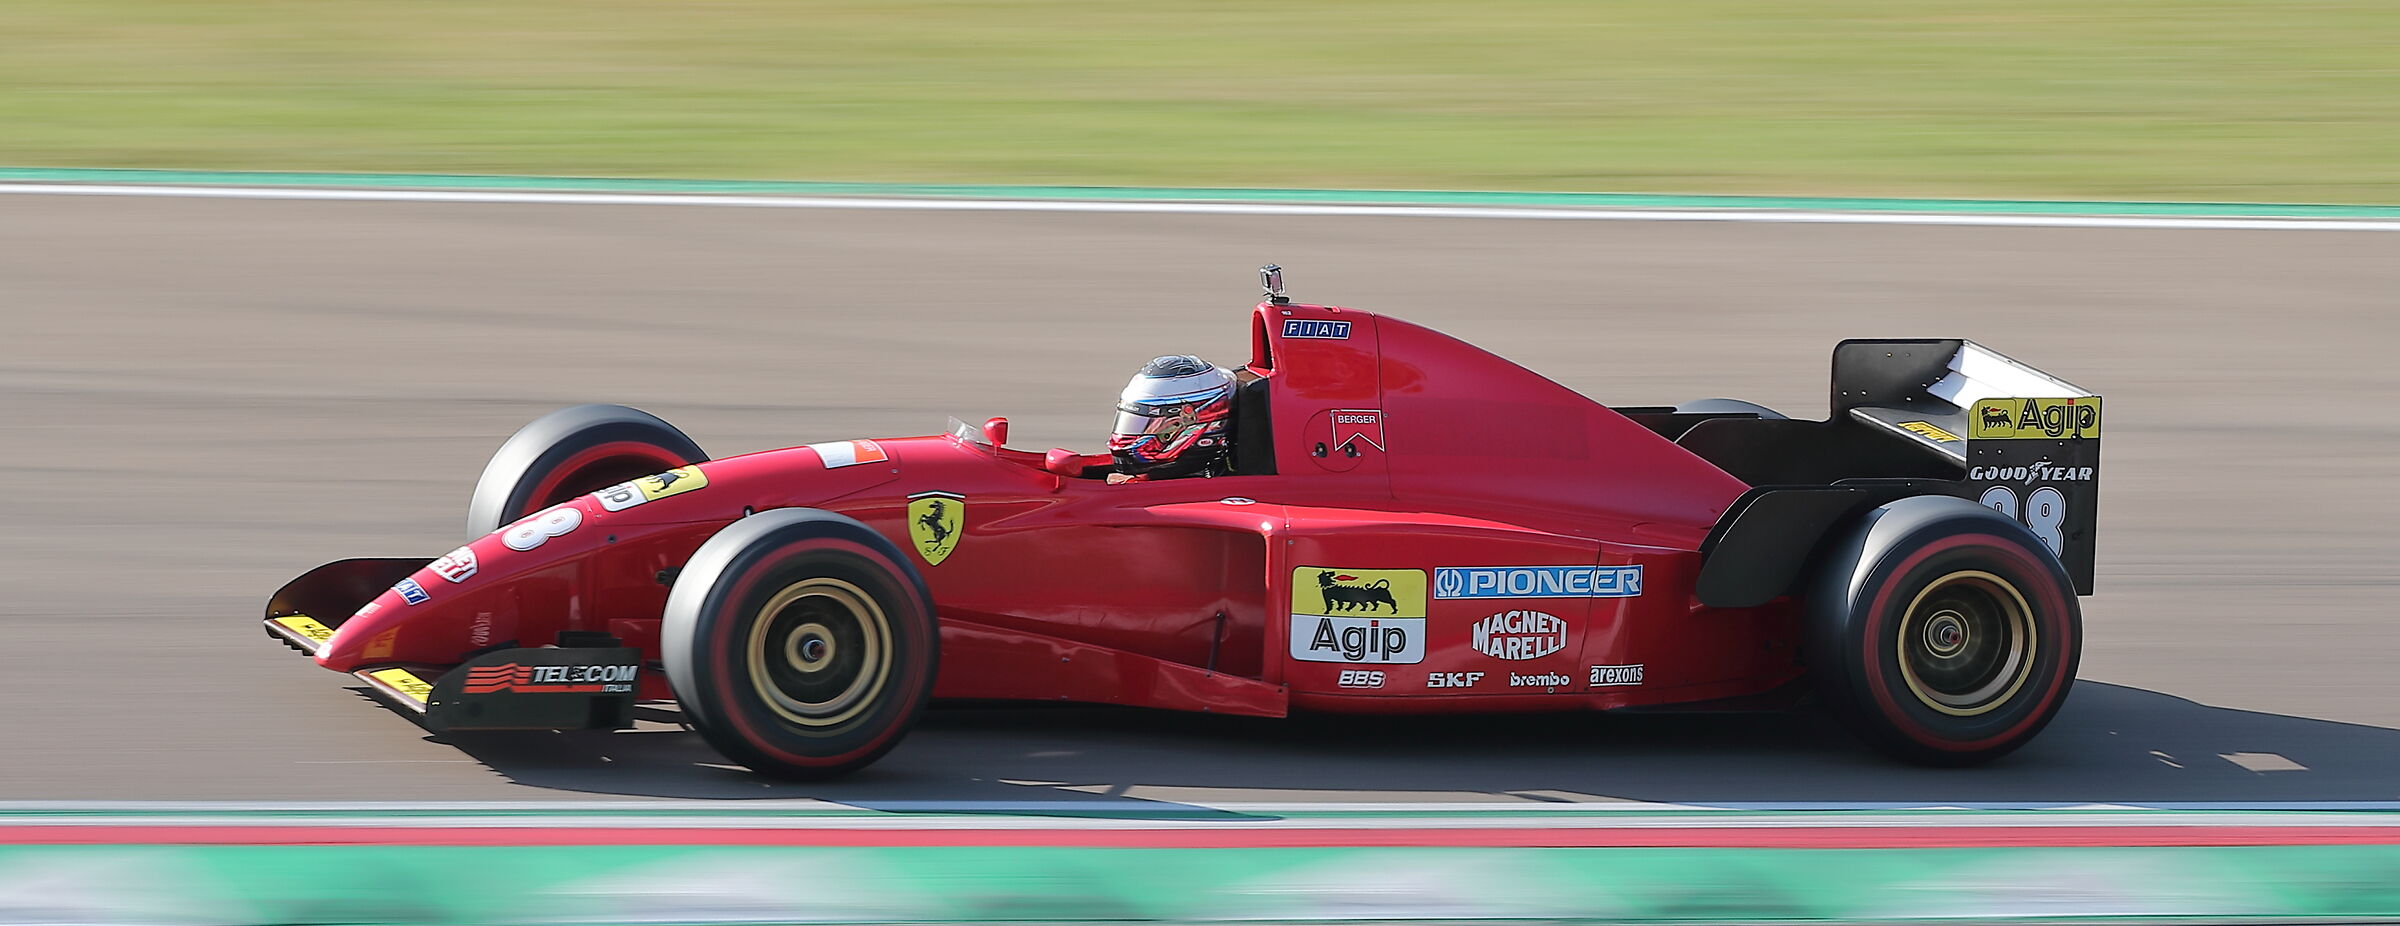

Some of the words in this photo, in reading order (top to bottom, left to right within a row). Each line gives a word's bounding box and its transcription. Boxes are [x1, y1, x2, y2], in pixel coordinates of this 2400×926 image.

[1287, 322, 1346, 336] FIAT
[1337, 415, 1377, 424] BERGER
[2016, 398, 2096, 440] Agip
[1469, 569, 1640, 595] PIONEER
[1472, 610, 1567, 638] MAGNETI
[1309, 617, 1407, 661] Agip
[1472, 634, 1567, 660] MARELLI
[533, 665, 639, 683] TELECOM
[1338, 669, 1386, 688] BBS
[1427, 671, 1485, 688] SKF
[1510, 671, 1570, 687] brembo
[1589, 665, 1643, 684] arexons
